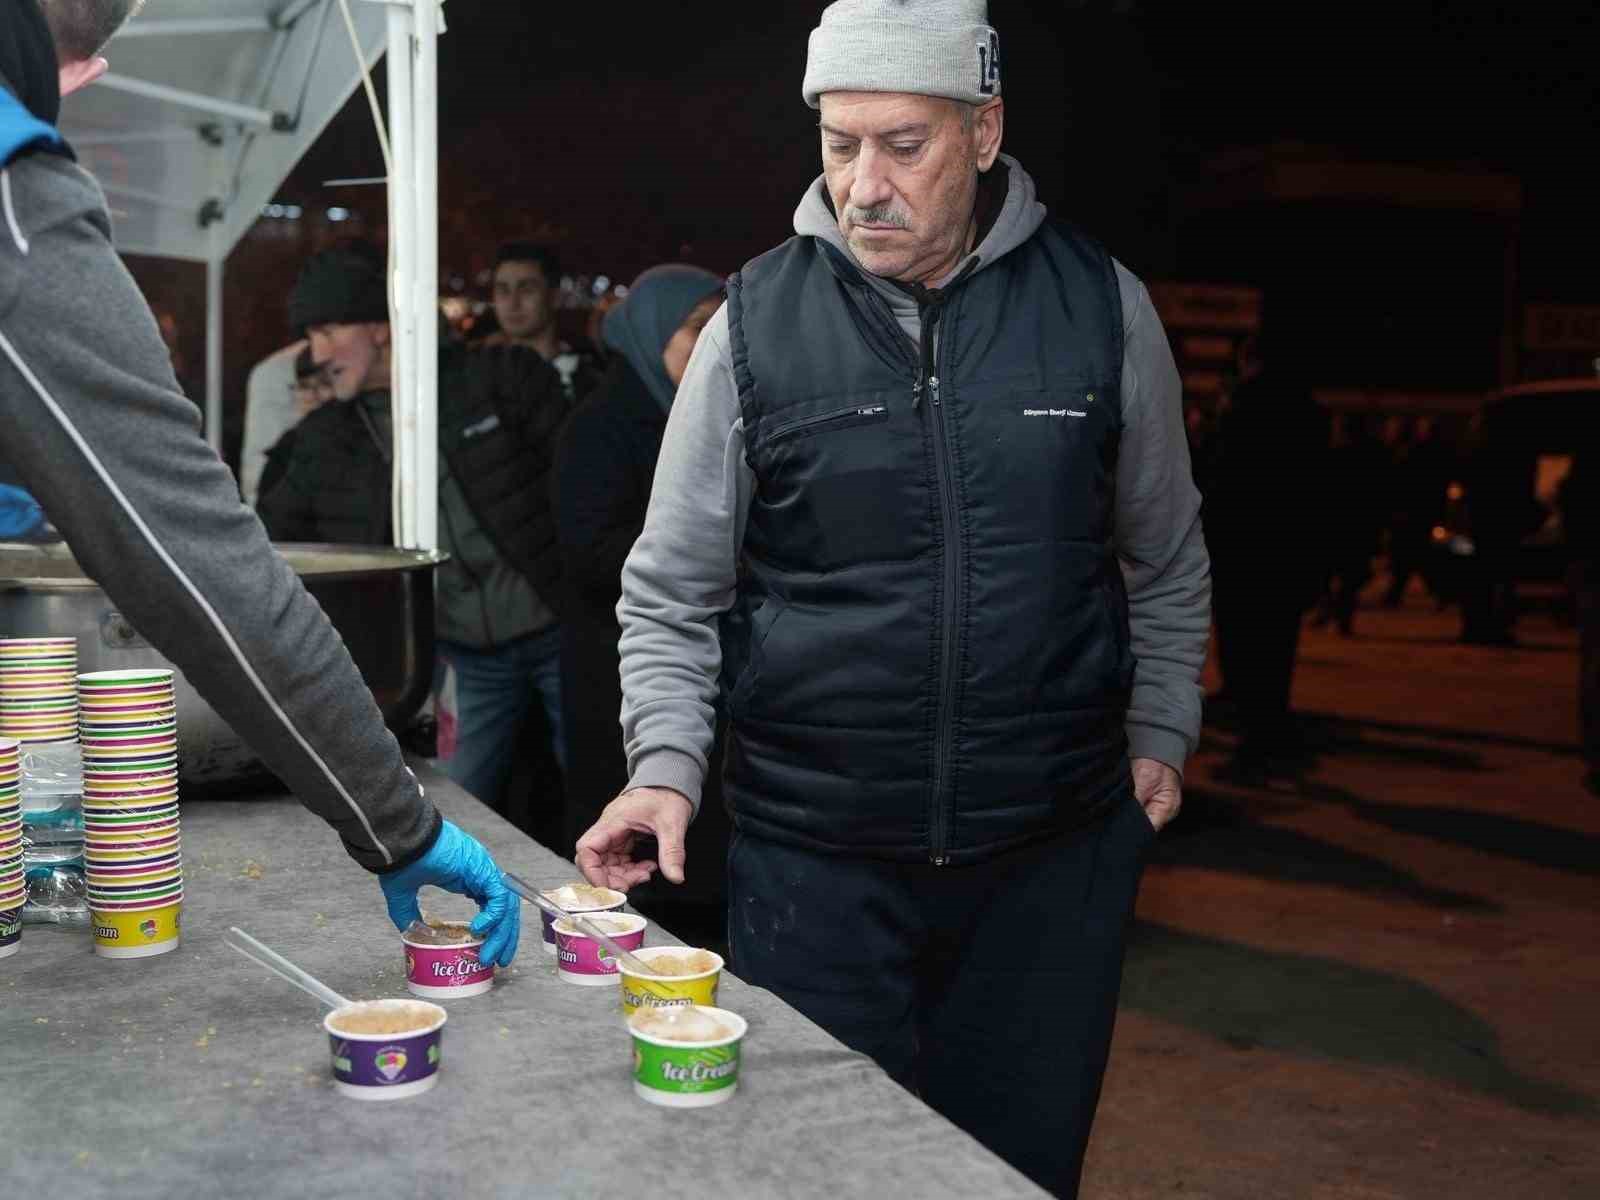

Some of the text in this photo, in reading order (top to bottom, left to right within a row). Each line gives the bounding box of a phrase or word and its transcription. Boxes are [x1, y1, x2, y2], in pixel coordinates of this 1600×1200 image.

[432, 959, 481, 976] Ice Cre
[662, 1061, 690, 1081] Ice
